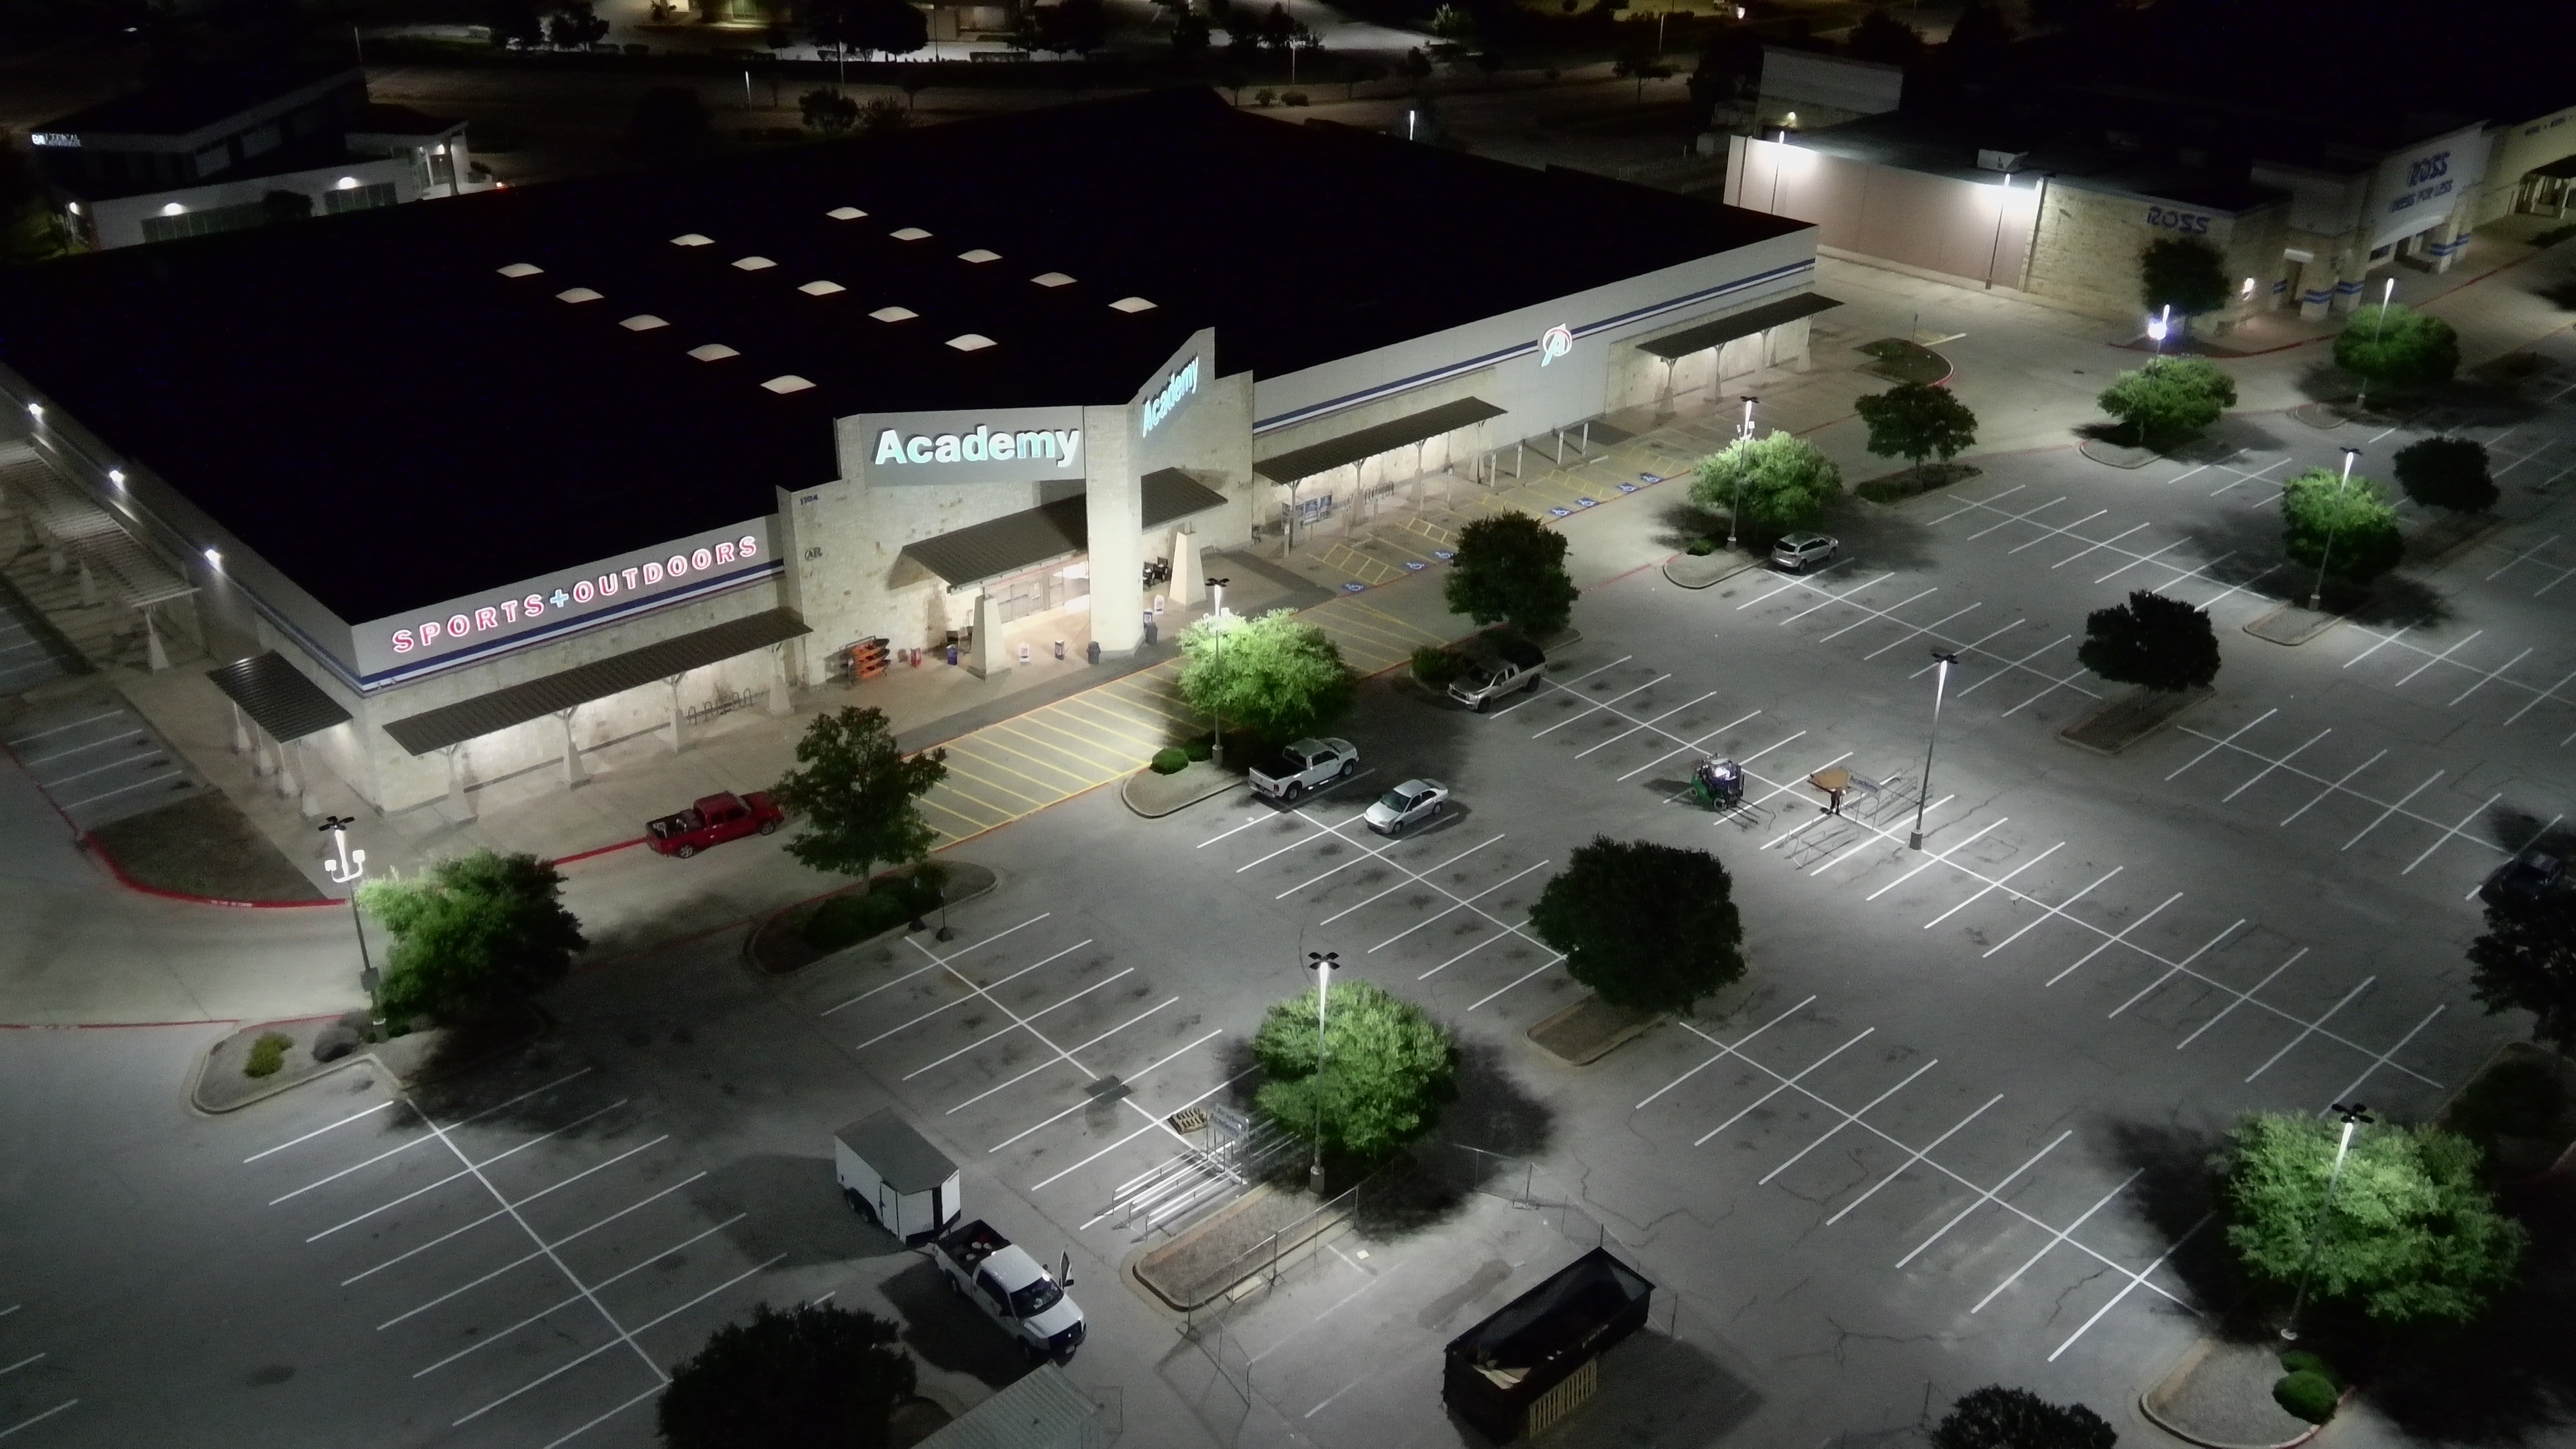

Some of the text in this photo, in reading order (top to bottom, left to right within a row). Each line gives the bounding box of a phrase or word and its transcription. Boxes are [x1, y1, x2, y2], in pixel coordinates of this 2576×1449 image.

[2147, 206, 2210, 234] ROSS
[1143, 356, 1199, 438] Academy
[875, 425, 1079, 467] Academy
